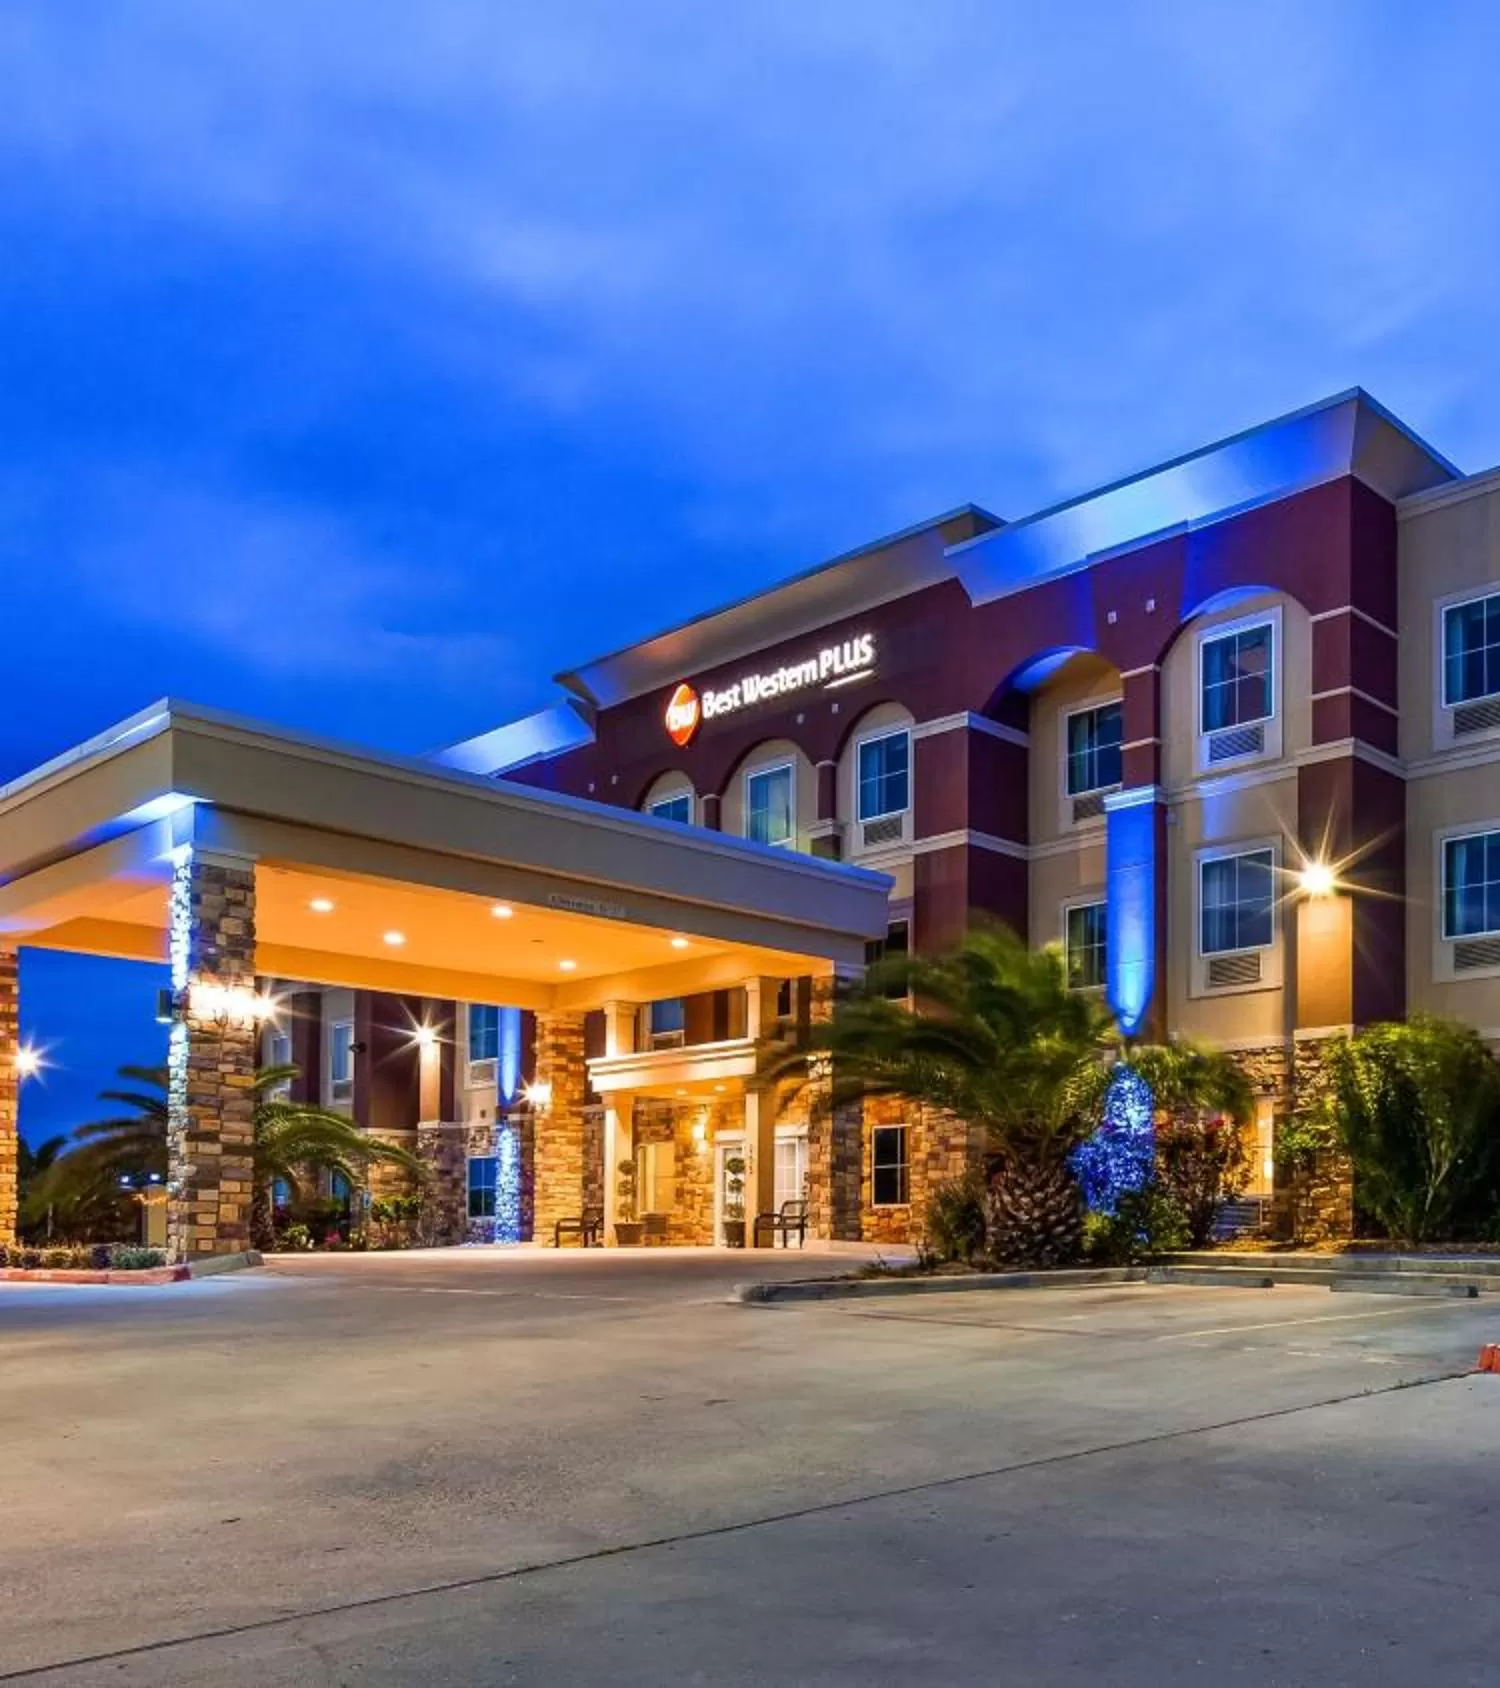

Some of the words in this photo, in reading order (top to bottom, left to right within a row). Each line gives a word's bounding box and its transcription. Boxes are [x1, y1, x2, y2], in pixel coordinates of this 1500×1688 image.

[702, 684, 740, 718] Best
[741, 659, 818, 704] Western
[819, 633, 873, 678] PLUS
